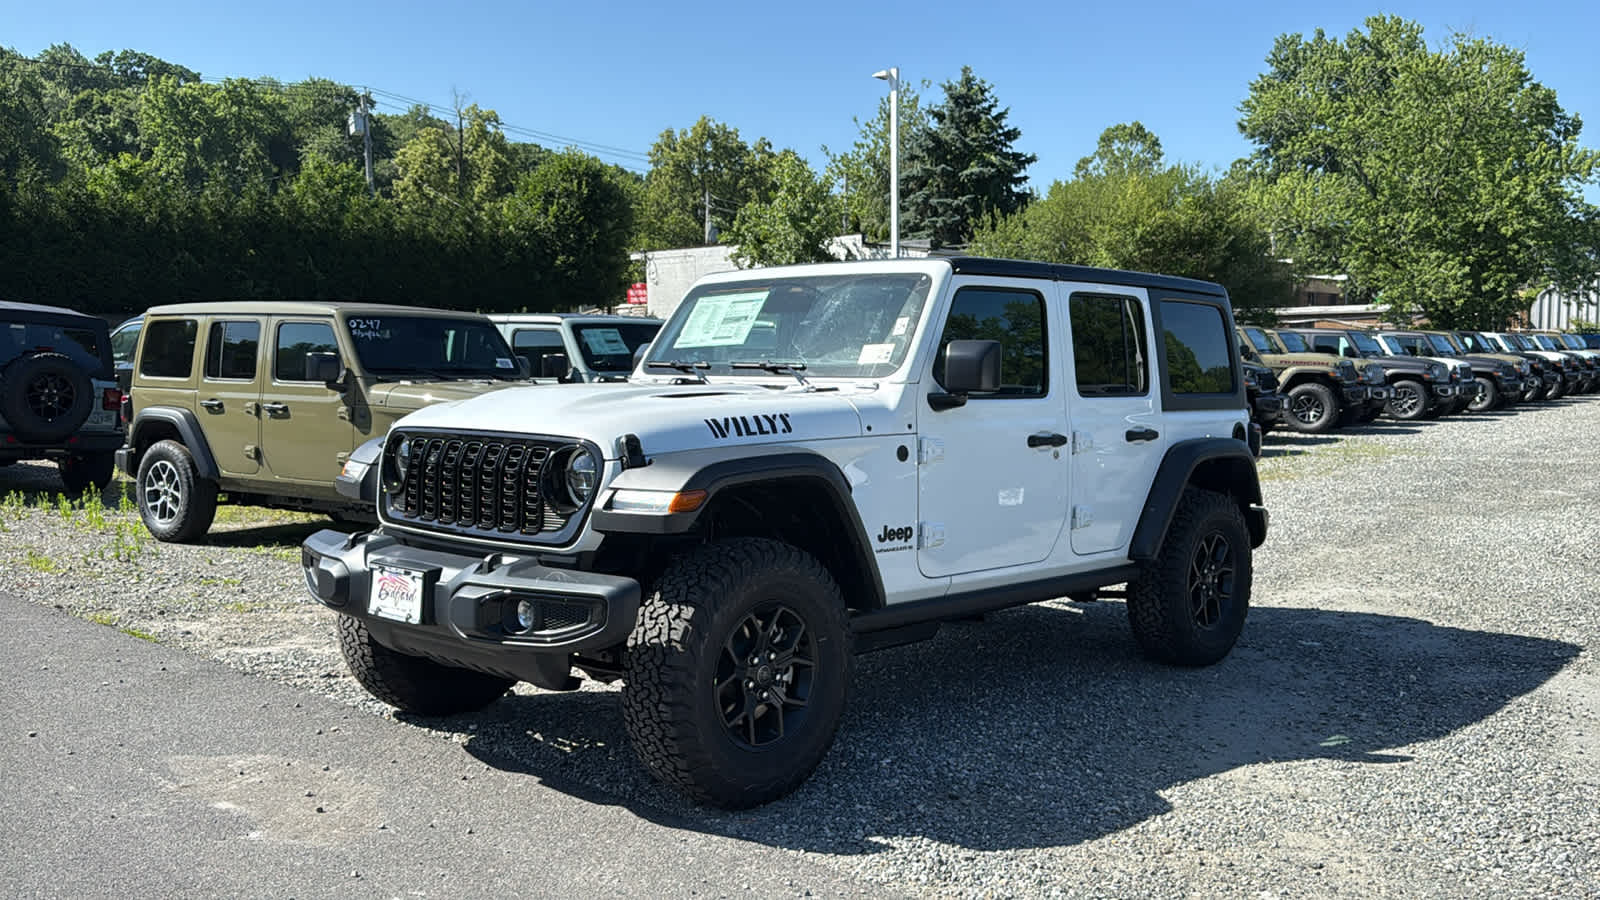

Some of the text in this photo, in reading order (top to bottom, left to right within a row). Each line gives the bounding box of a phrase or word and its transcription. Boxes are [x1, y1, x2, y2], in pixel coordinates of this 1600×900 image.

[349, 319, 380, 329] 0247
[704, 413, 792, 438] WILLYS
[877, 525, 913, 542] Jeep
